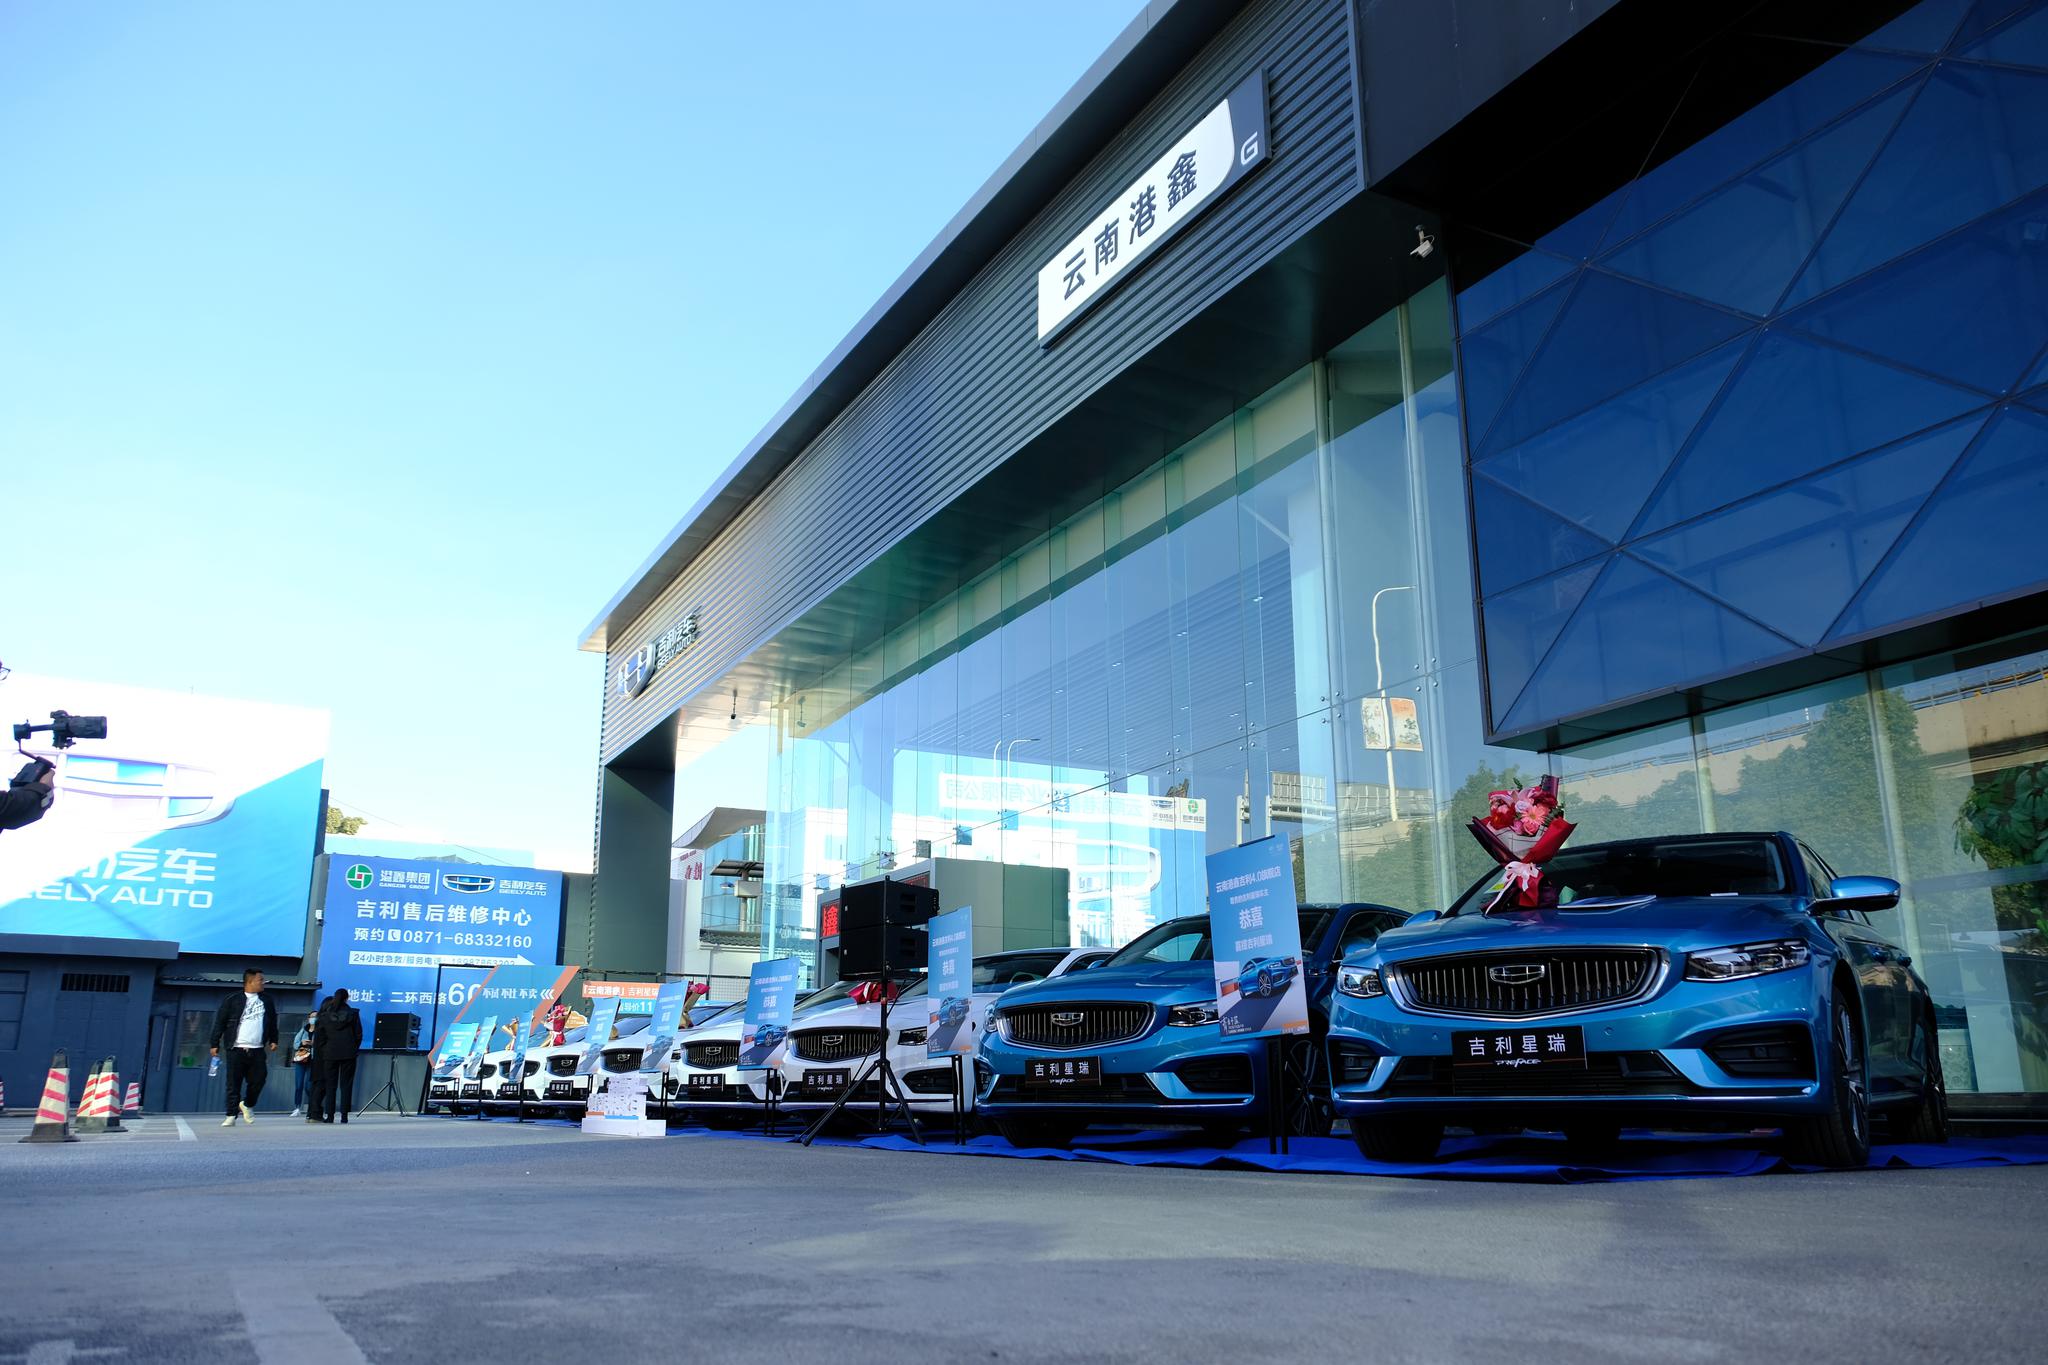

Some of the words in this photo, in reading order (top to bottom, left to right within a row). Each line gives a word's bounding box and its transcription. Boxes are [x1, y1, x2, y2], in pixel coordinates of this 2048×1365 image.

[1062, 149, 1197, 301] 云南港鑫
[111, 886, 214, 909] AUTO
[356, 899, 533, 927] 吉利售后维修中心
[1239, 906, 1263, 930] 恭喜
[354, 927, 384, 942] 预约
[403, 930, 533, 948] 0871-68332160
[1468, 1032, 1566, 1057] 吉利星瑞
[1034, 1061, 1089, 1077] 吉利星瑞
